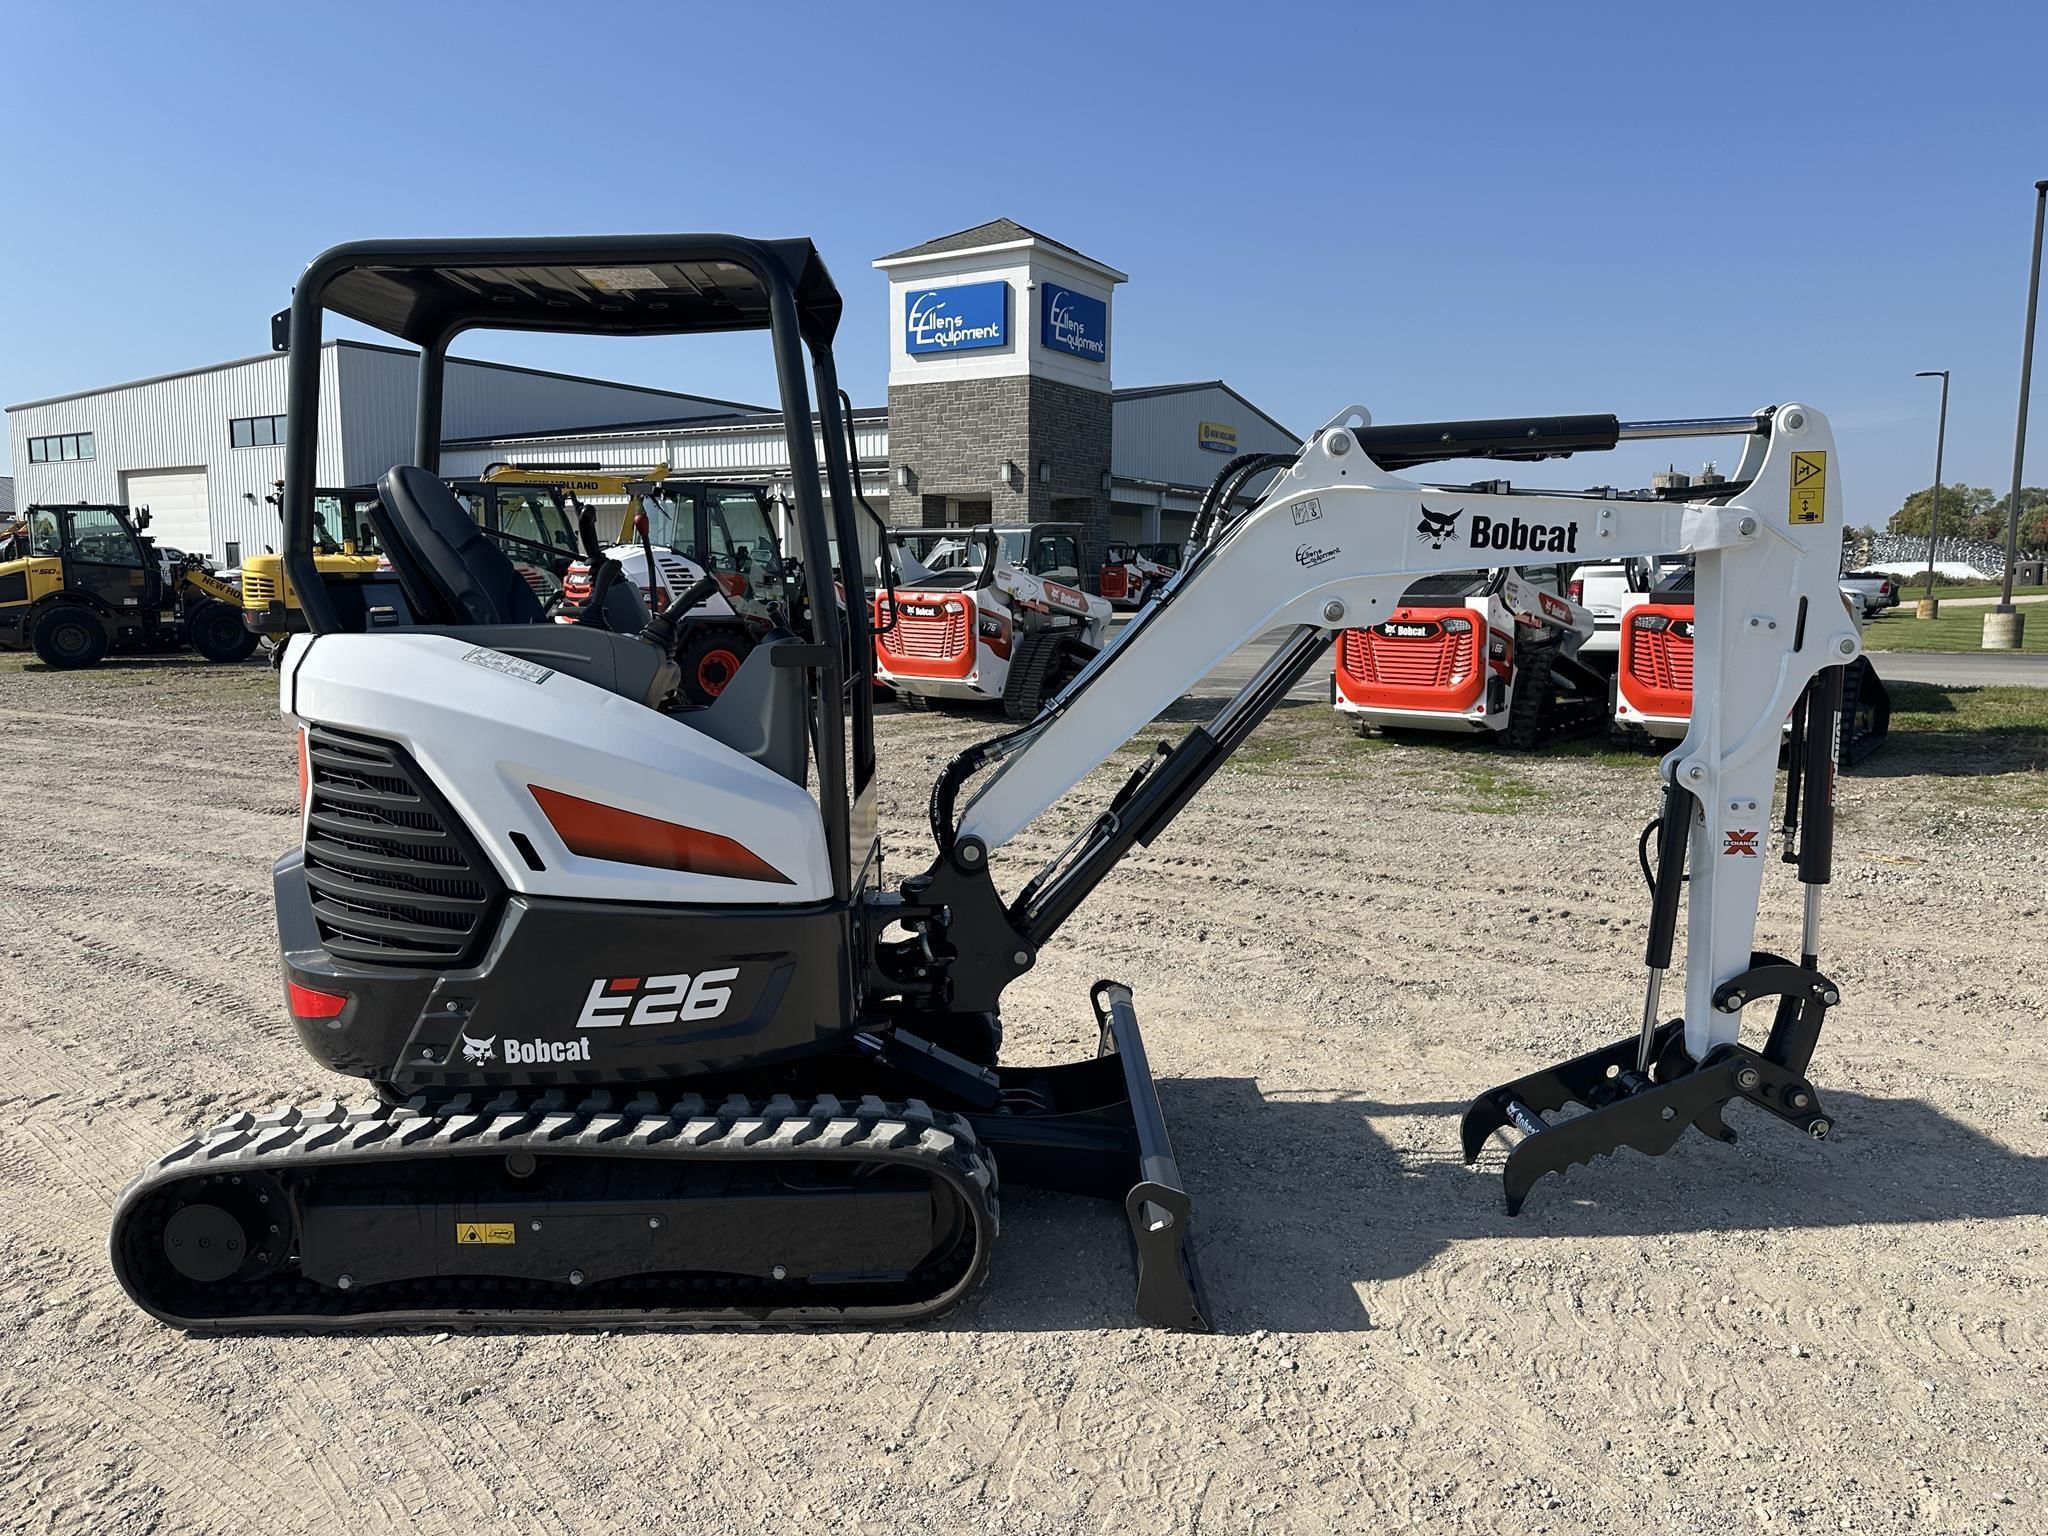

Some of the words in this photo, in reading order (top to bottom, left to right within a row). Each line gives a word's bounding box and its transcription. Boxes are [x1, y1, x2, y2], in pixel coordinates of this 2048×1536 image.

[909, 292, 963, 332] Ellens
[917, 302, 999, 347] Equipment
[1050, 291, 1085, 334] Ellens
[1055, 306, 1104, 354] Equipment
[1470, 515, 1579, 554] Bobcat
[202, 576, 226, 591] NEW
[1061, 592, 1080, 608] Bobcat
[915, 607, 934, 616] Bobcat
[1397, 626, 1426, 637] Bobcat
[576, 967, 740, 1028] E26
[504, 1037, 591, 1064] Bobcat
